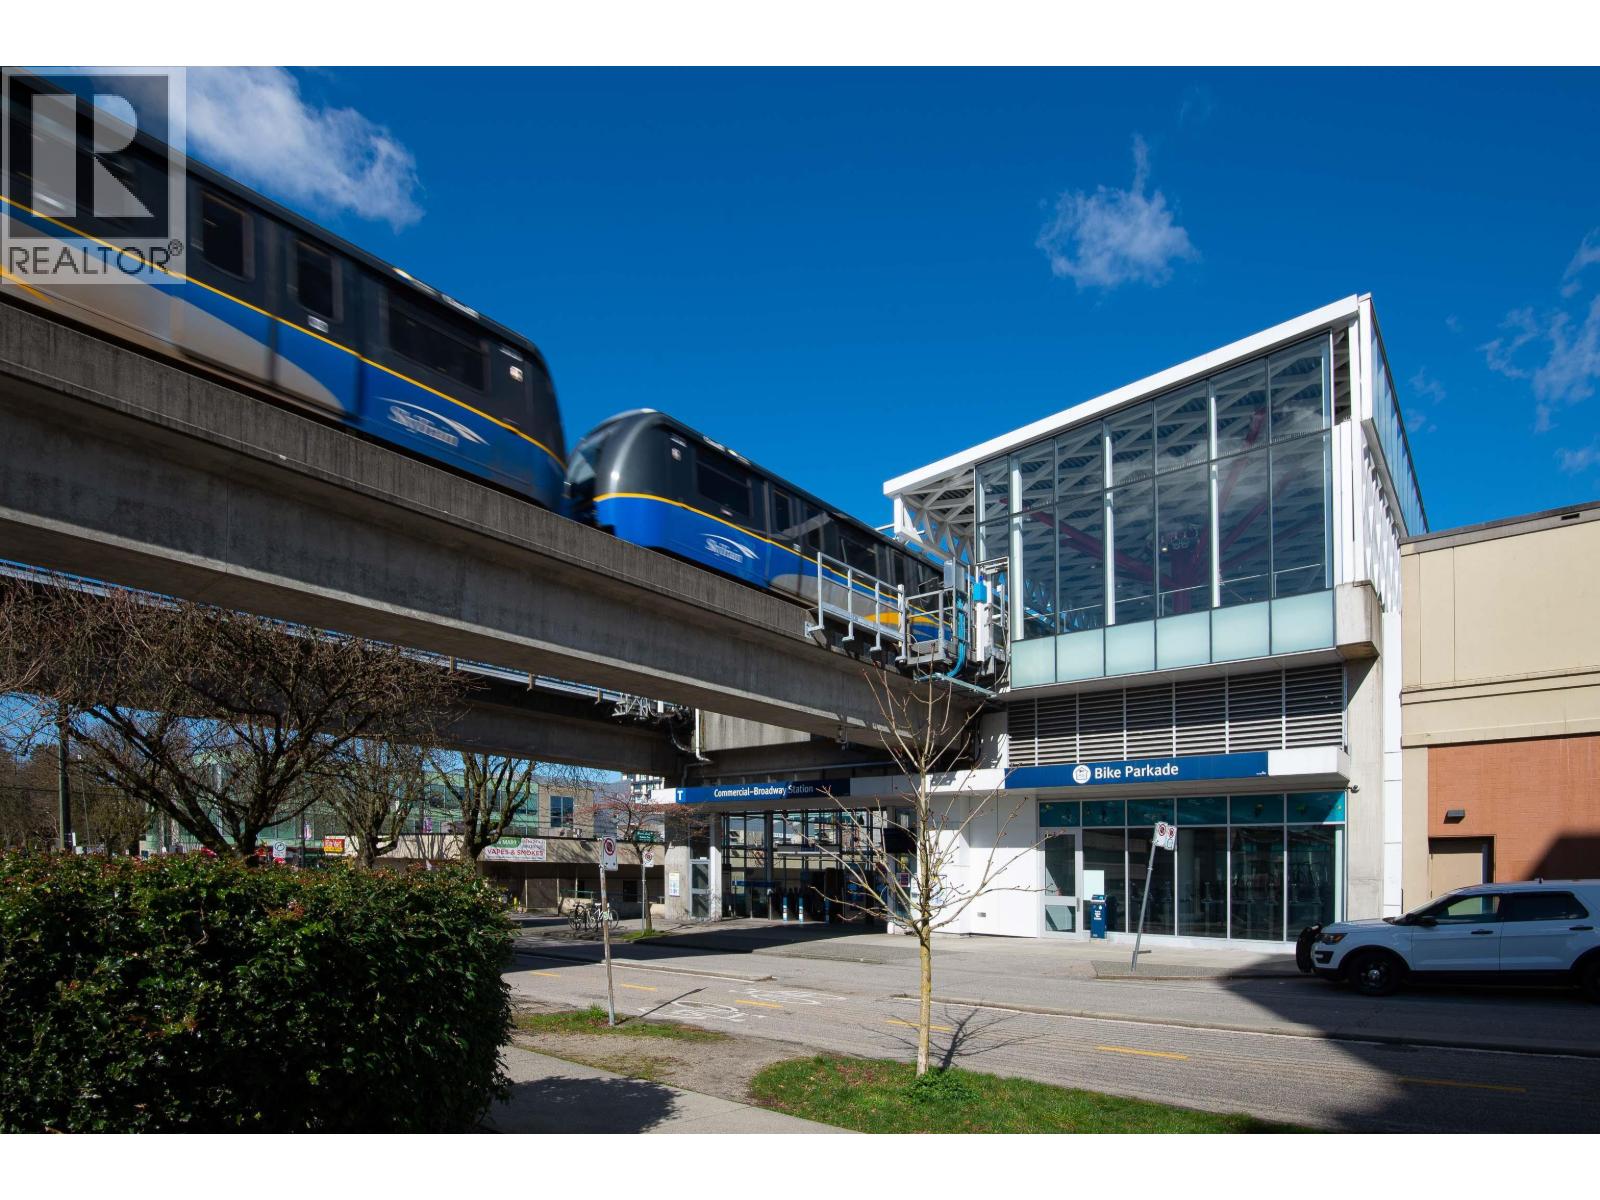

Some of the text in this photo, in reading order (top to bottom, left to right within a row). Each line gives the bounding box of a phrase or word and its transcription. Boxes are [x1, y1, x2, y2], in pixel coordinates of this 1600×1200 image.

[1094, 763, 1179, 779] Bike Parkade
[677, 790, 684, 800] T
[788, 784, 814, 794] Station
[517, 849, 544, 857] SMOKES
